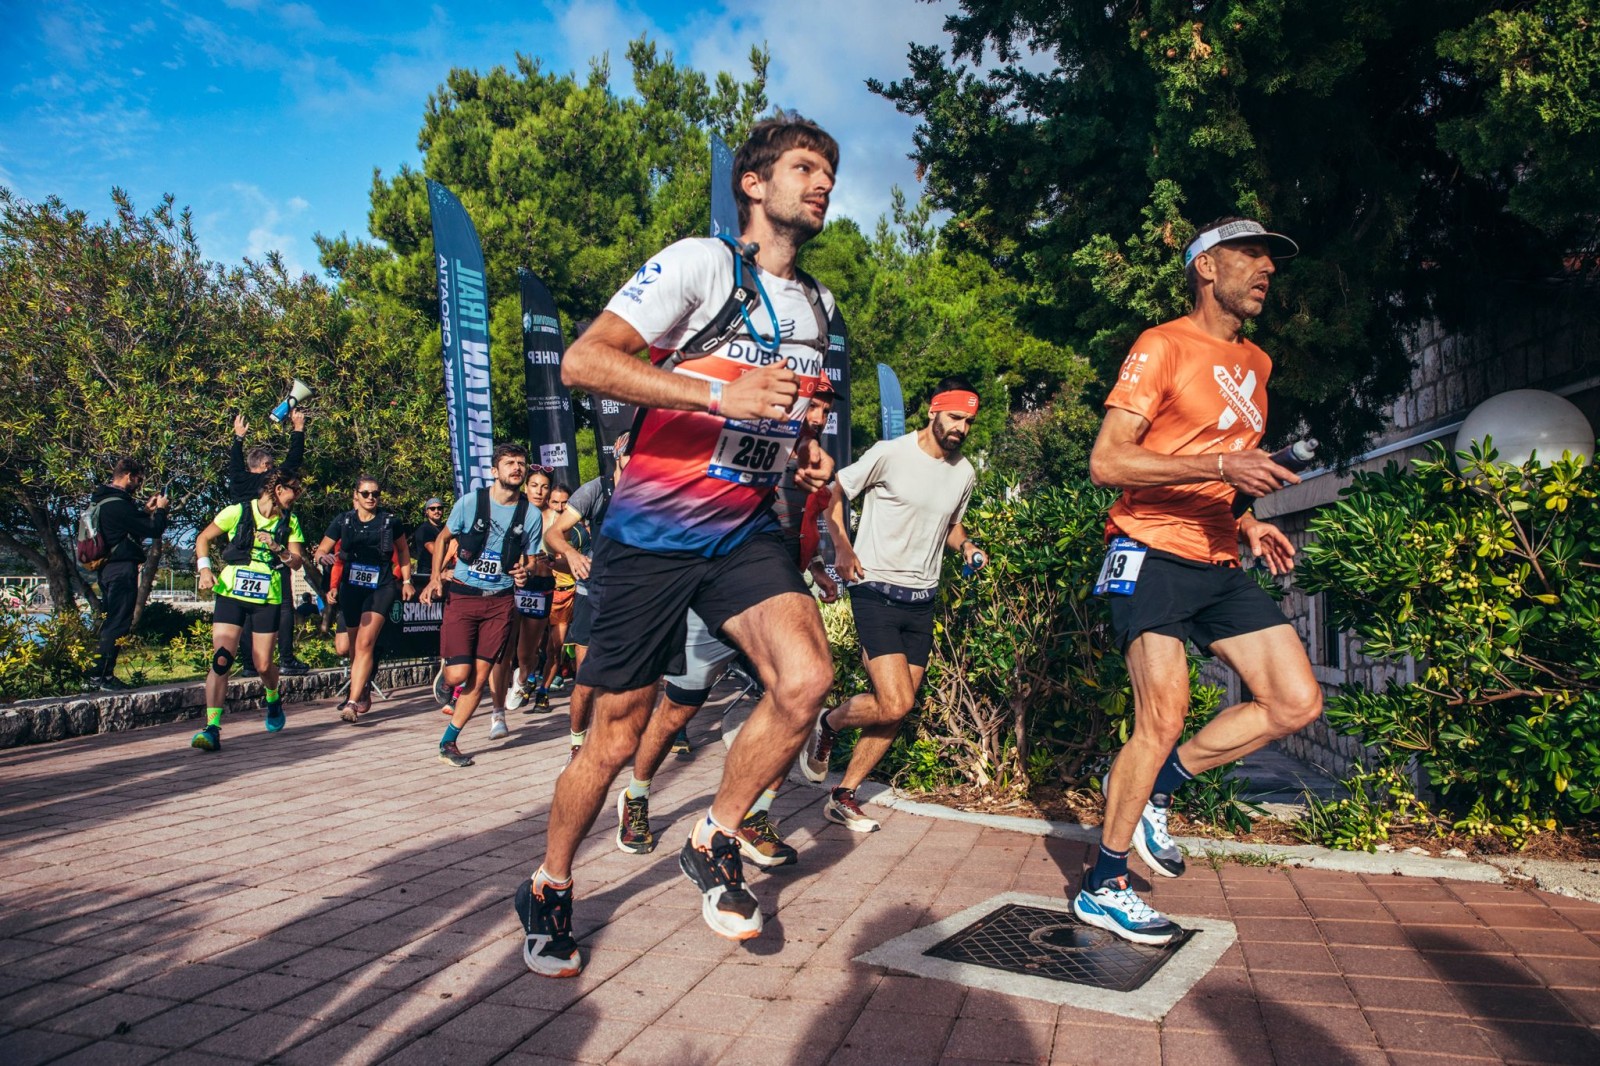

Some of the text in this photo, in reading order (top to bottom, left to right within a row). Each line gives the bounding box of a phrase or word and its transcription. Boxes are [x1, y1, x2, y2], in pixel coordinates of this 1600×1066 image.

[1218, 387, 1251, 429] TRIATHLON
[731, 435, 780, 472] 258
[475, 559, 498, 575] 238
[355, 571, 372, 583] 266
[240, 579, 262, 592] 274
[520, 596, 538, 609] 224
[402, 602, 443, 621] SPARTAN
